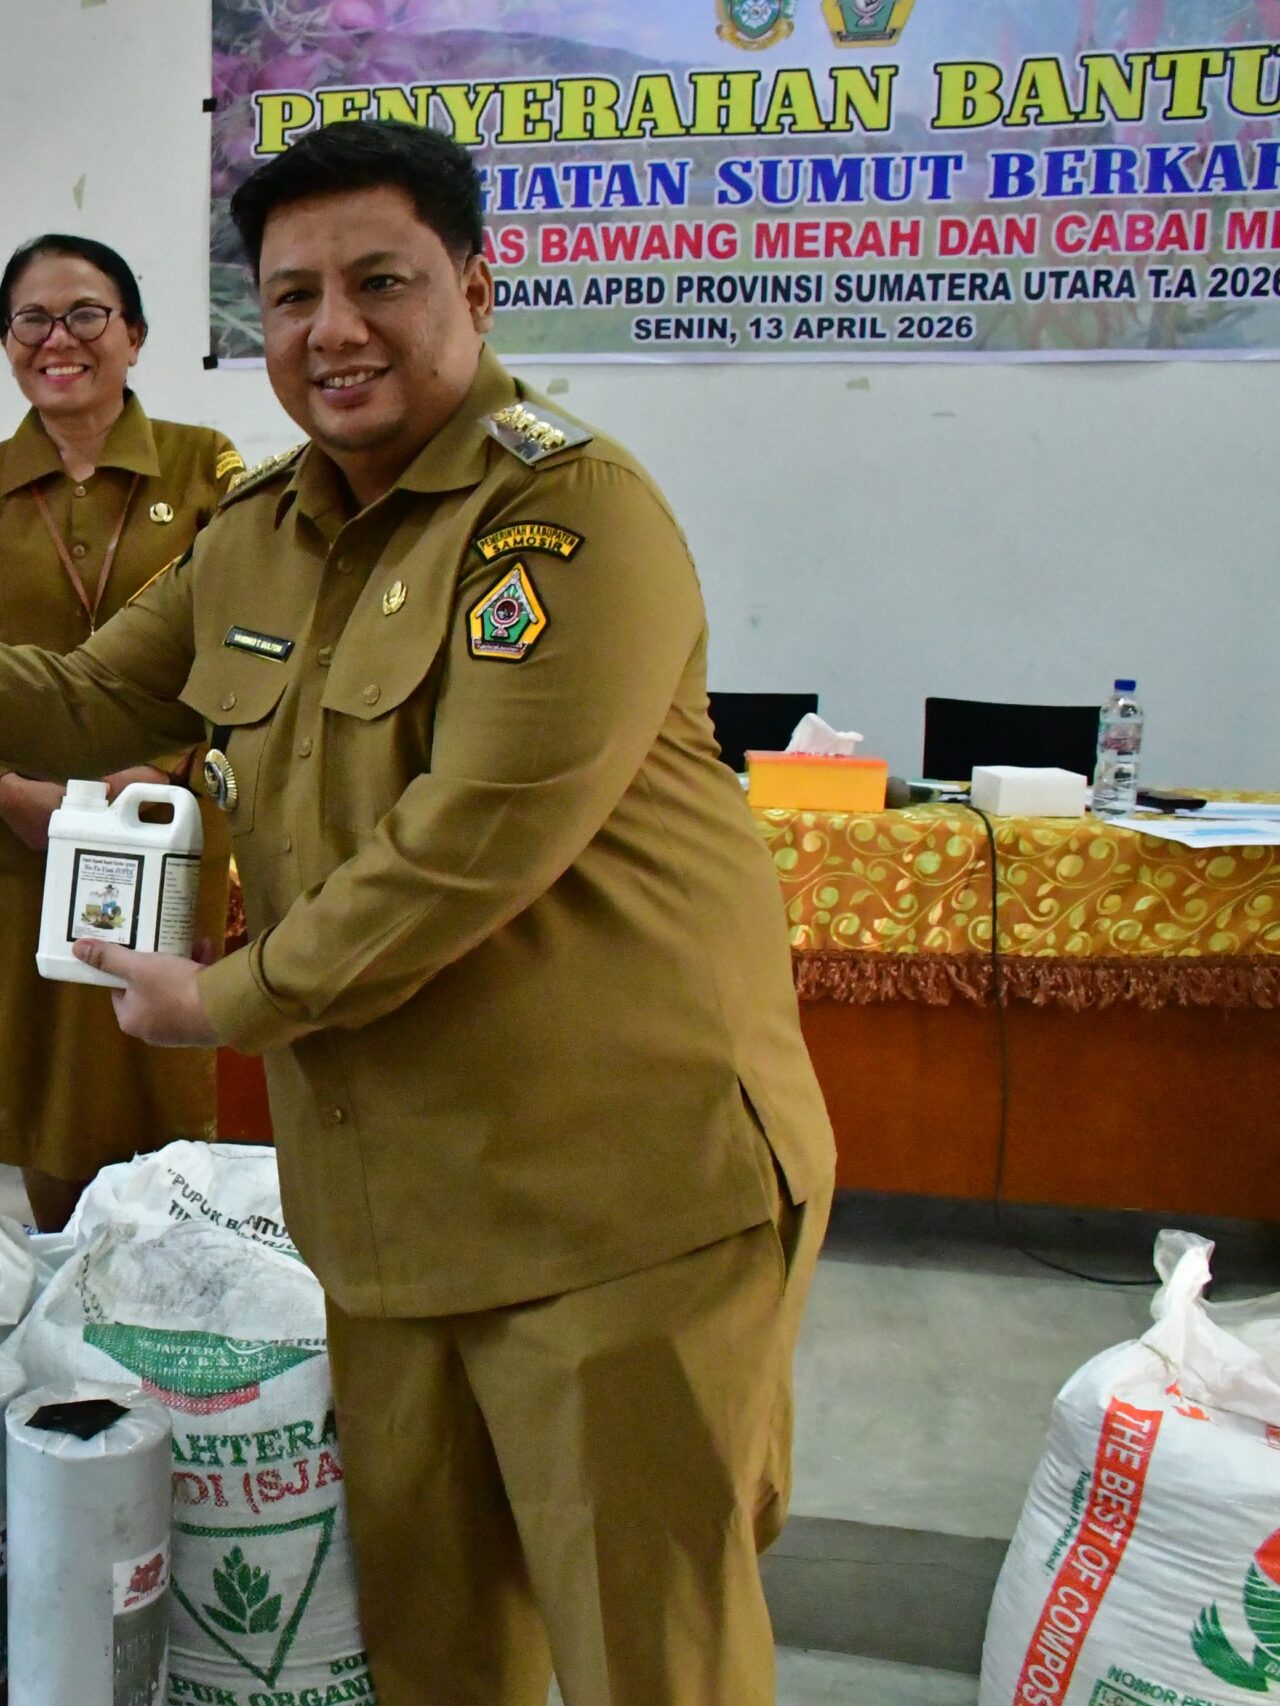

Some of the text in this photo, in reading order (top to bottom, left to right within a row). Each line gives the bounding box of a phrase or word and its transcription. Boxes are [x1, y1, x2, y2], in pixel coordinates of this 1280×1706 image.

[254, 45, 1280, 154] PENYERAHAN BANTU
[717, 153, 963, 205] SUMUT
[541, 222, 738, 264] BAWANG
[754, 219, 921, 260] MERAH
[938, 216, 1037, 257] DAN
[1055, 211, 1208, 254] CABAI
[493, 278, 574, 307] DANA
[583, 276, 666, 305] APBD
[676, 273, 823, 305] PROVINSI
[834, 270, 1012, 303] SUMATERA
[1023, 268, 1138, 301] UTARA
[1148, 267, 1198, 299] T.A
[634, 315, 974, 344] SENIN, 13 APRIL 2026
[480, 525, 576, 548] PEMERINTAH KABUPATEN
[493, 537, 563, 554] SAMOSIR
[1105, 1410, 1152, 1470] THE
[1087, 1468, 1136, 1548] BEST
[1070, 1544, 1111, 1591] OF
[1107, 1664, 1178, 1705] NOMOR
